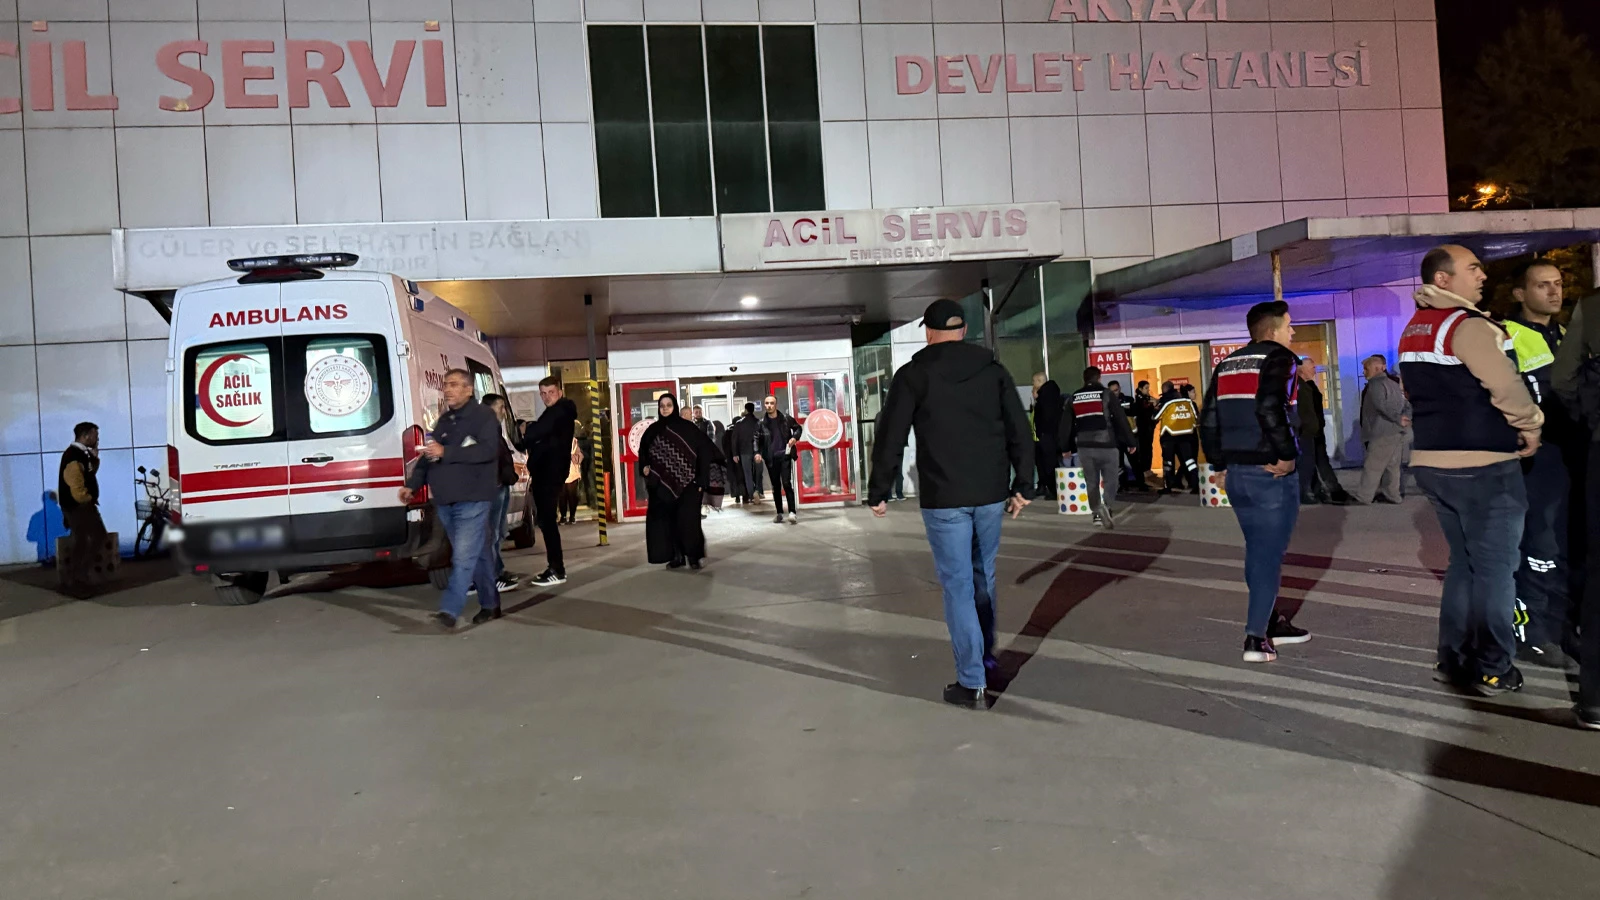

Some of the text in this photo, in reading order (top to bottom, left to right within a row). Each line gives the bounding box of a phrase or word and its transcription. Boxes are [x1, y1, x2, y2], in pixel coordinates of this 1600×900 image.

[156, 21, 447, 111] SERVİ
[895, 40, 1371, 95] DEVLET HASTANESİ
[850, 245, 946, 260] EMERGENCY
[209, 303, 348, 328] AMBULANS
[224, 372, 252, 389] ACİL
[216, 390, 262, 408] SAĞLIK
[213, 461, 261, 470] TRANSIT
